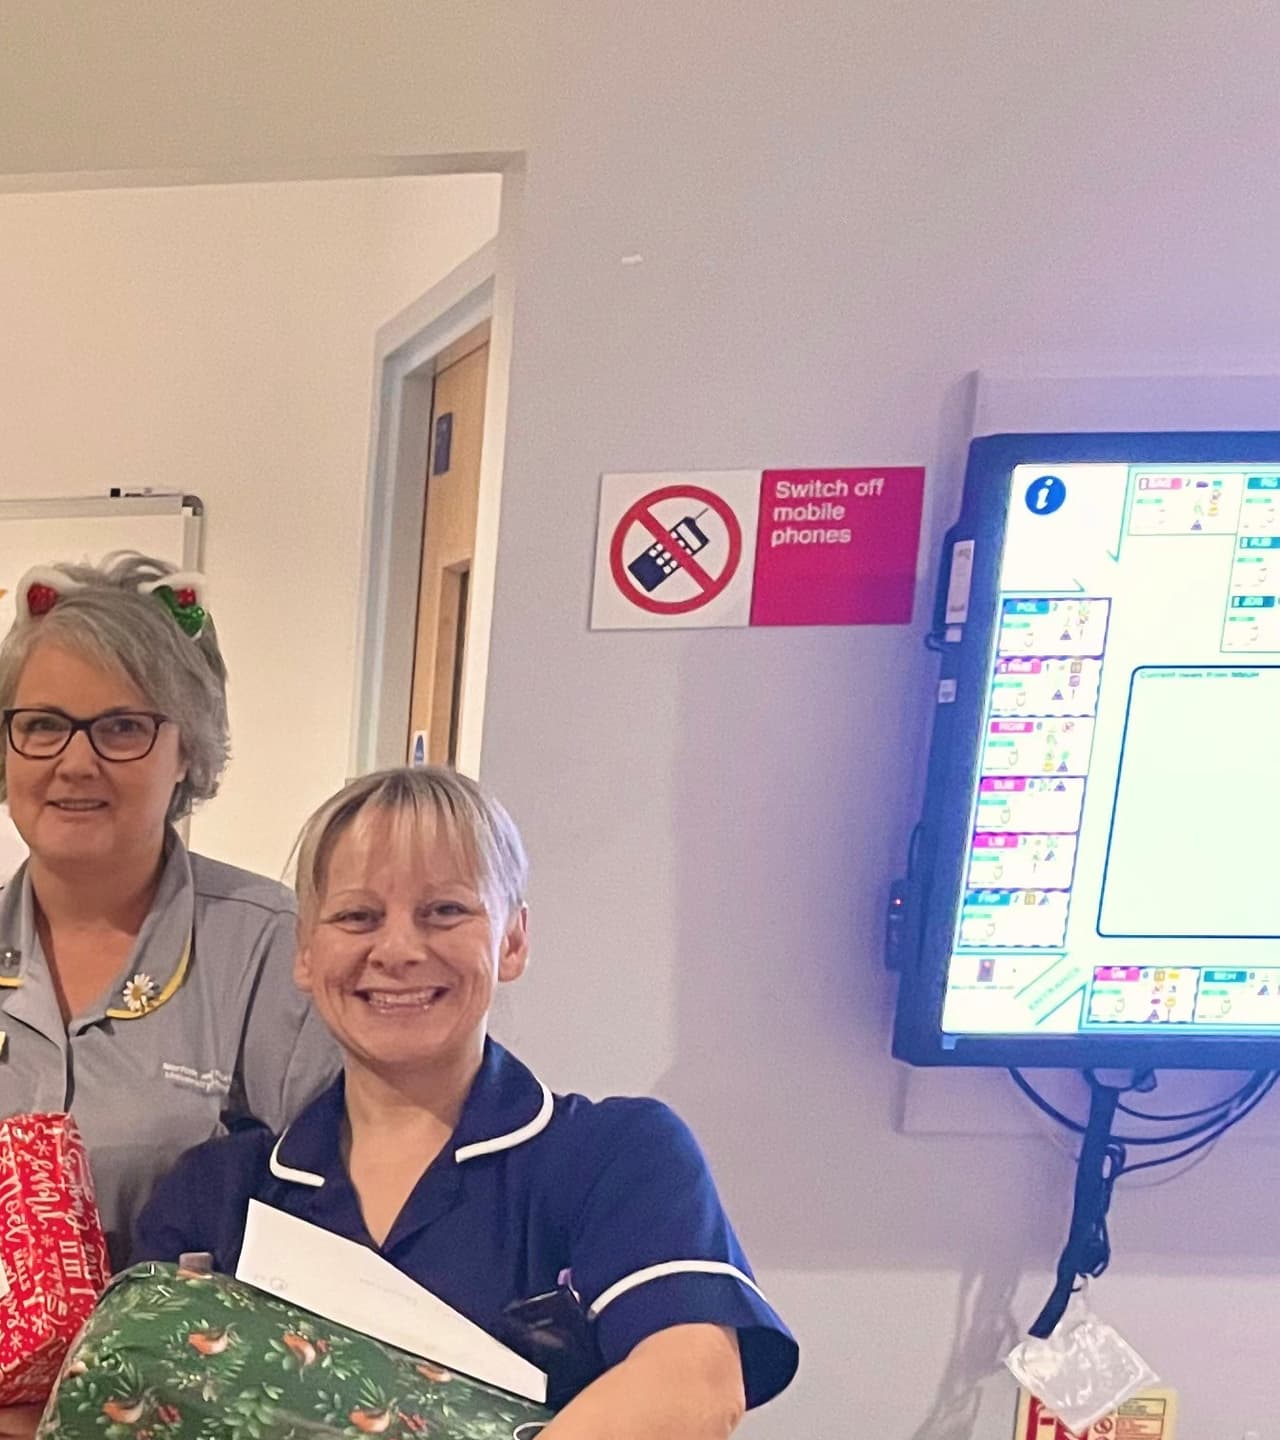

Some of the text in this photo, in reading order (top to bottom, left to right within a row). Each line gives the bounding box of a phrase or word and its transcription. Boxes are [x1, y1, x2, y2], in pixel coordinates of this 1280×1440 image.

[776, 478, 885, 498] Switch off
[773, 503, 846, 521] mobile
[771, 527, 851, 547] phones
